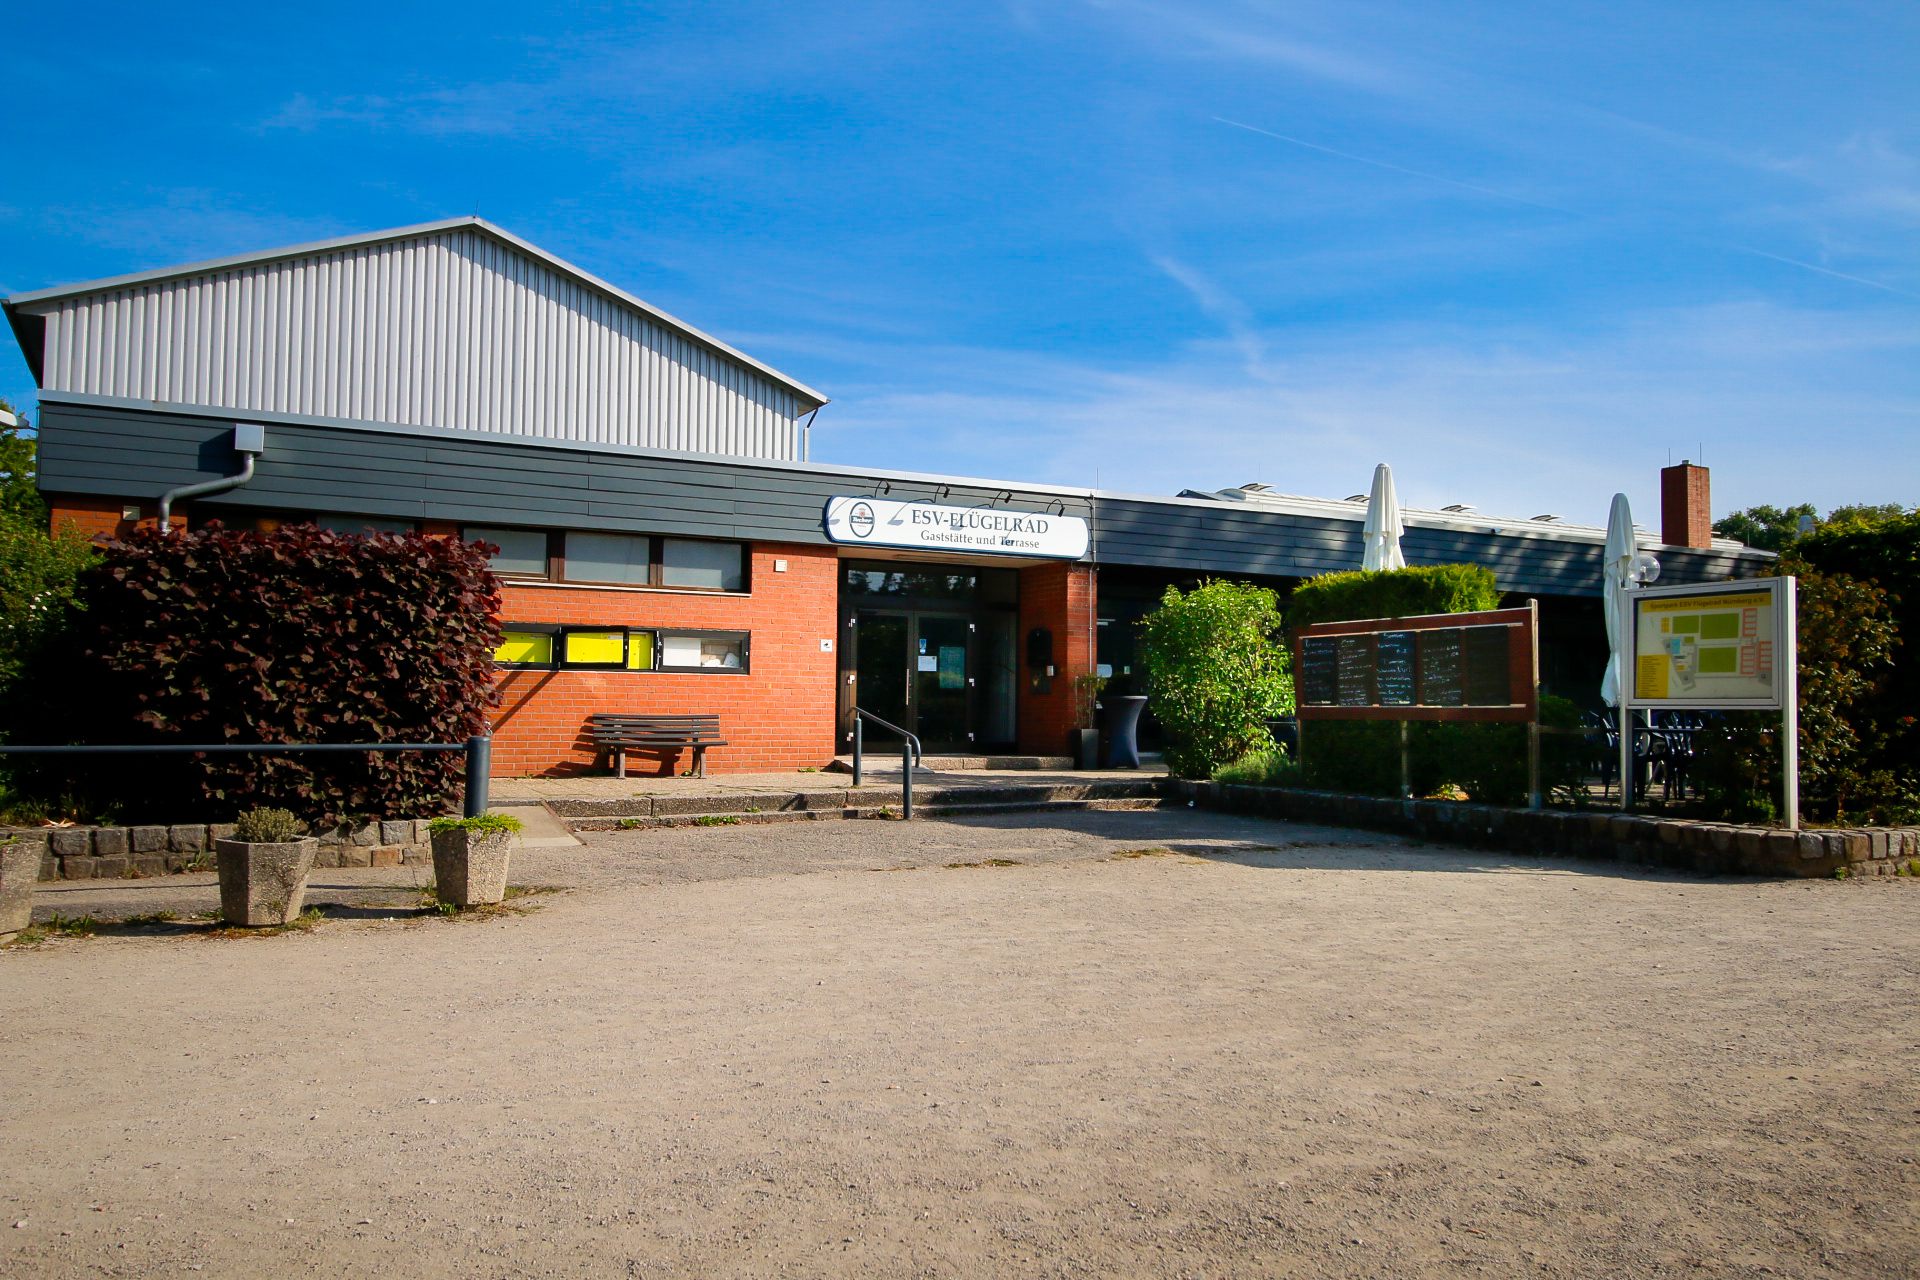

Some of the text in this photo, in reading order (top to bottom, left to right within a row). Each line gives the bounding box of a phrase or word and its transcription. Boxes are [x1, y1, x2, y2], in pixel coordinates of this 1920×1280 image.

[912, 509, 1049, 534] ESV-FLÜGELRAD
[920, 530, 1040, 549] Gaststätte und Terrasse
[1650, 602, 1678, 610] Sportpark
[1693, 599, 1722, 608] Flügelrad
[1723, 597, 1752, 606] Nürnberg
